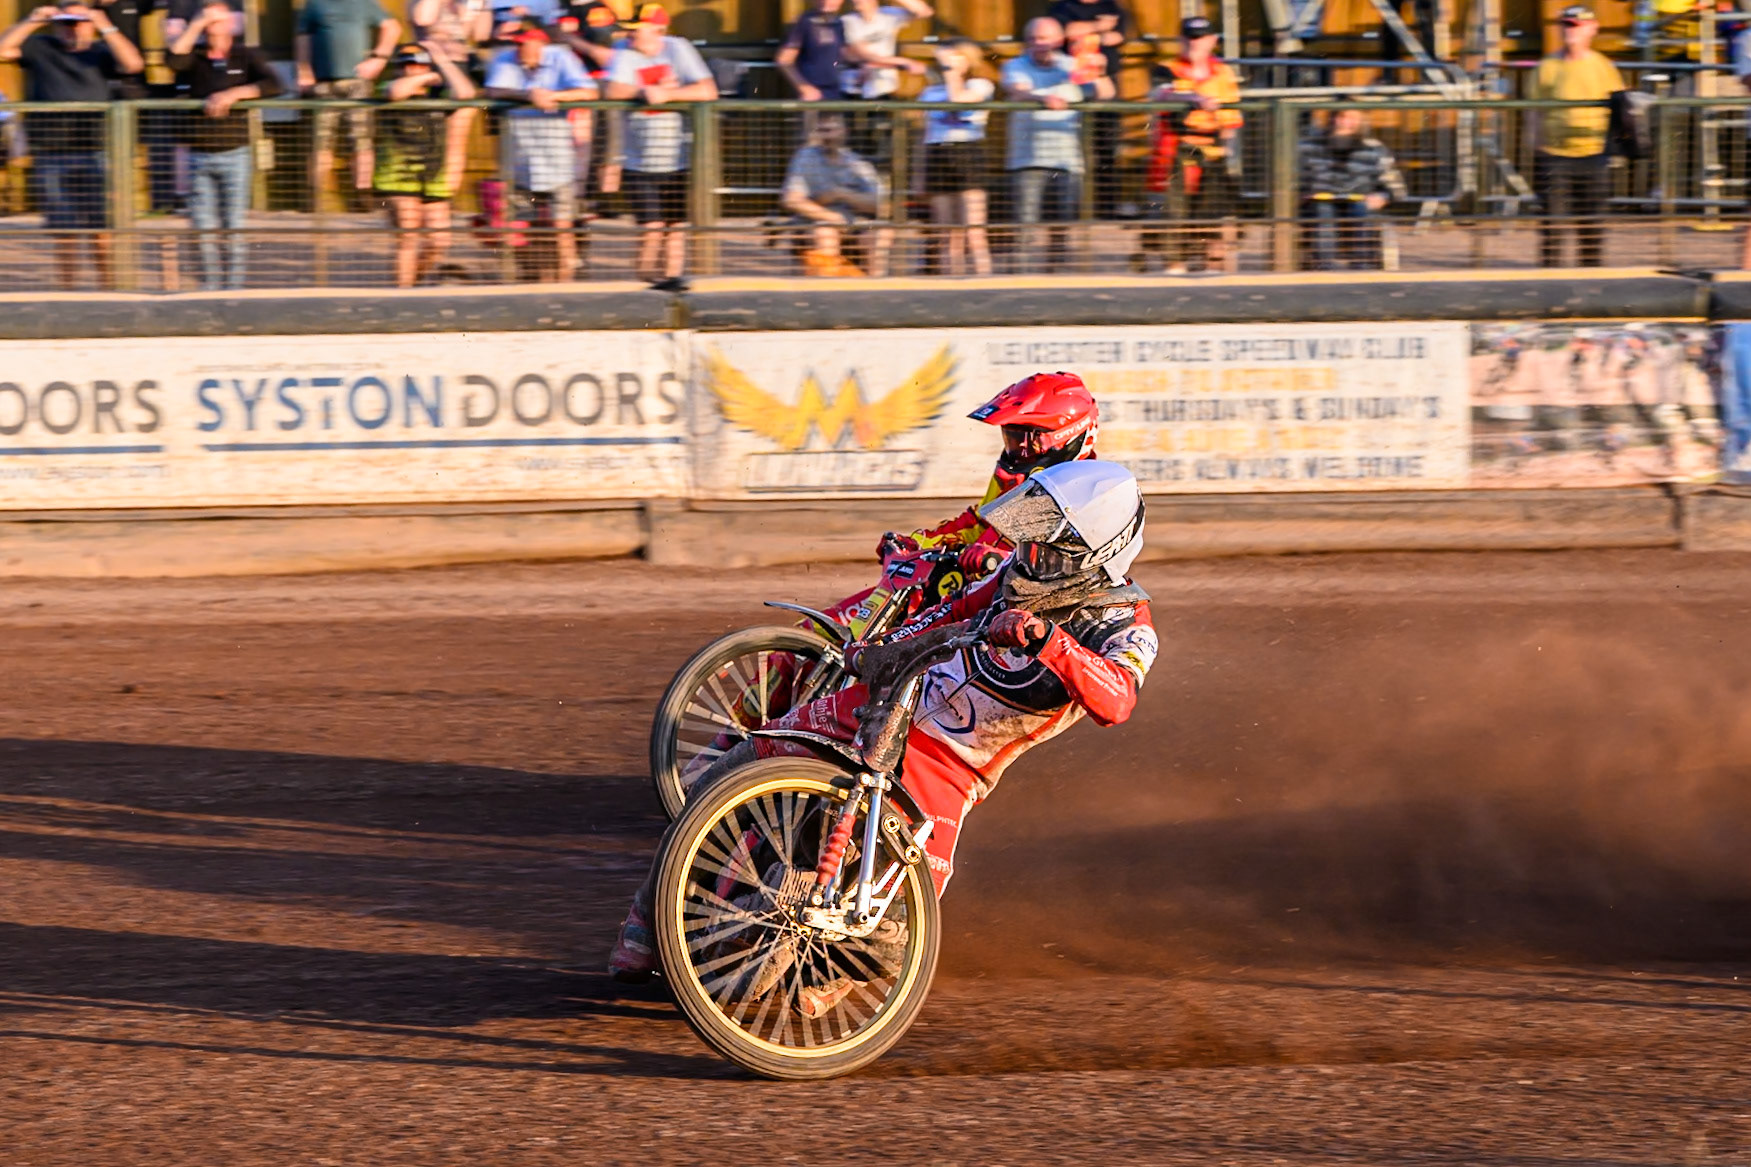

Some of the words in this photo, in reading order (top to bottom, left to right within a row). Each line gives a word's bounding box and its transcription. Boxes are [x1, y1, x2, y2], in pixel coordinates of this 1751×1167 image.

[0, 380, 161, 436] OORS
[197, 376, 443, 431] SYSTON
[462, 373, 679, 427] DOORS
